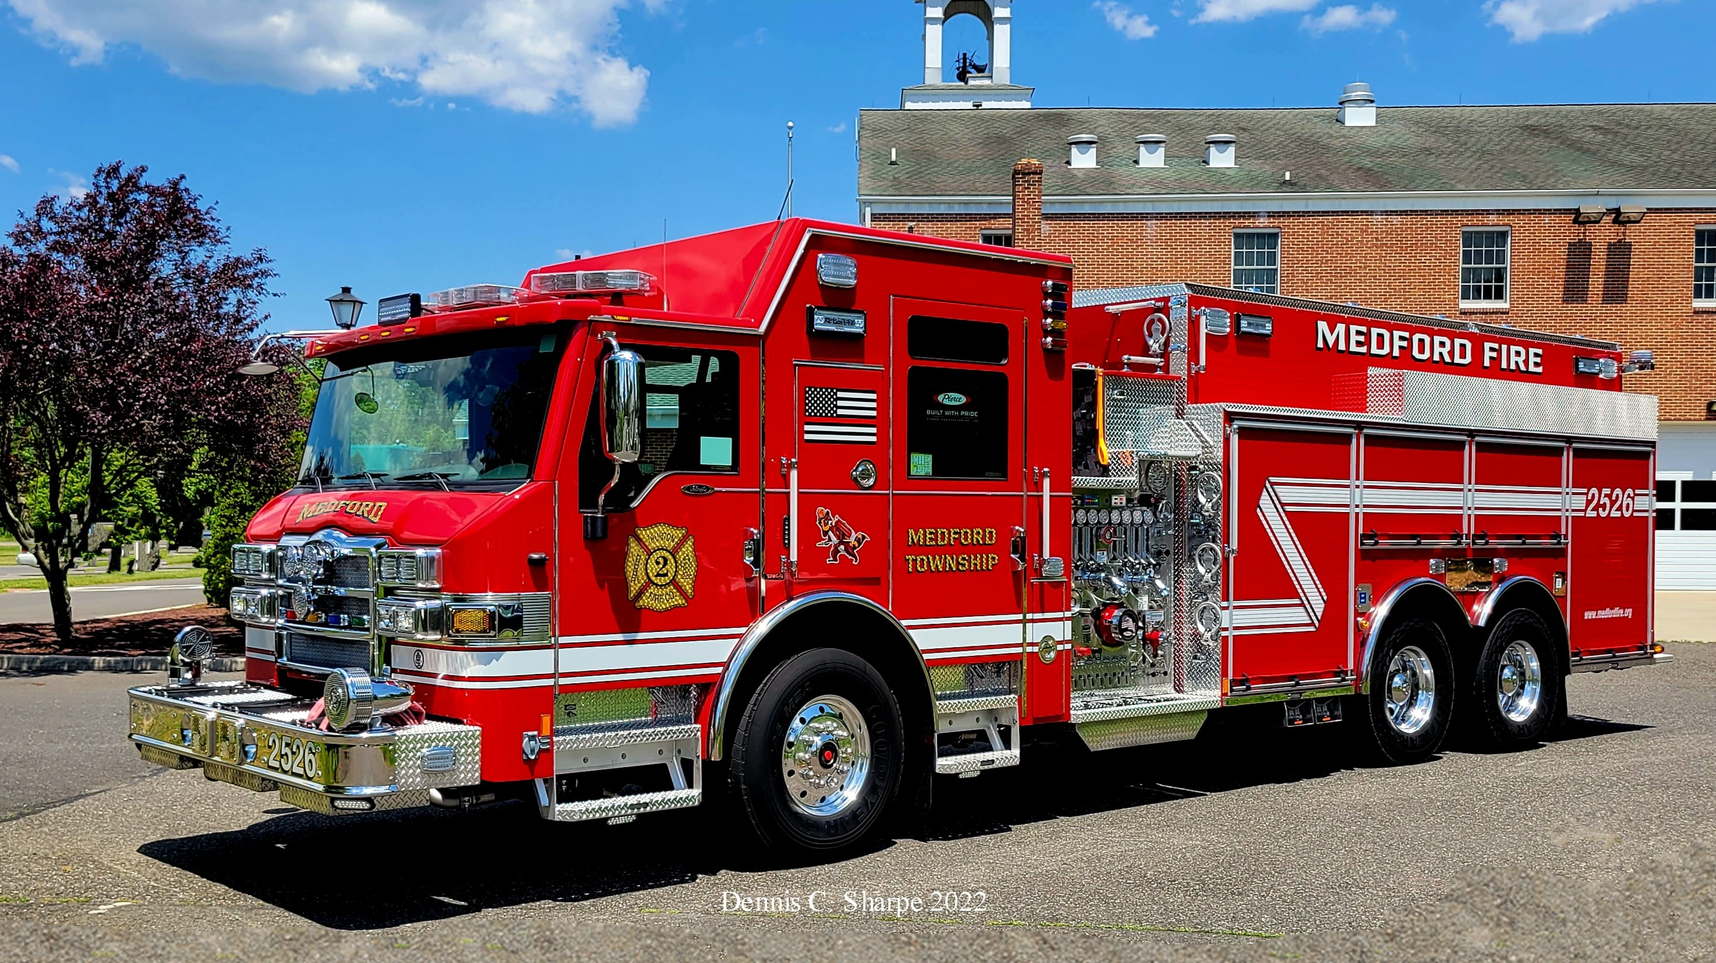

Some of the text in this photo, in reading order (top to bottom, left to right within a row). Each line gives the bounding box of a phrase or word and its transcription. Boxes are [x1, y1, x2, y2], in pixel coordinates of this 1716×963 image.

[1316, 320, 1543, 375] MEDFORD FIRE
[941, 393, 964, 403] Pierce
[295, 500, 388, 525] MEDFORD
[1585, 487, 1635, 518] 2526
[907, 527, 997, 546] MEDFORD
[654, 555, 669, 578] 2
[905, 553, 999, 573] TOWNSHIP
[648, 591, 664, 603] FIRE
[267, 732, 317, 780] 2526
